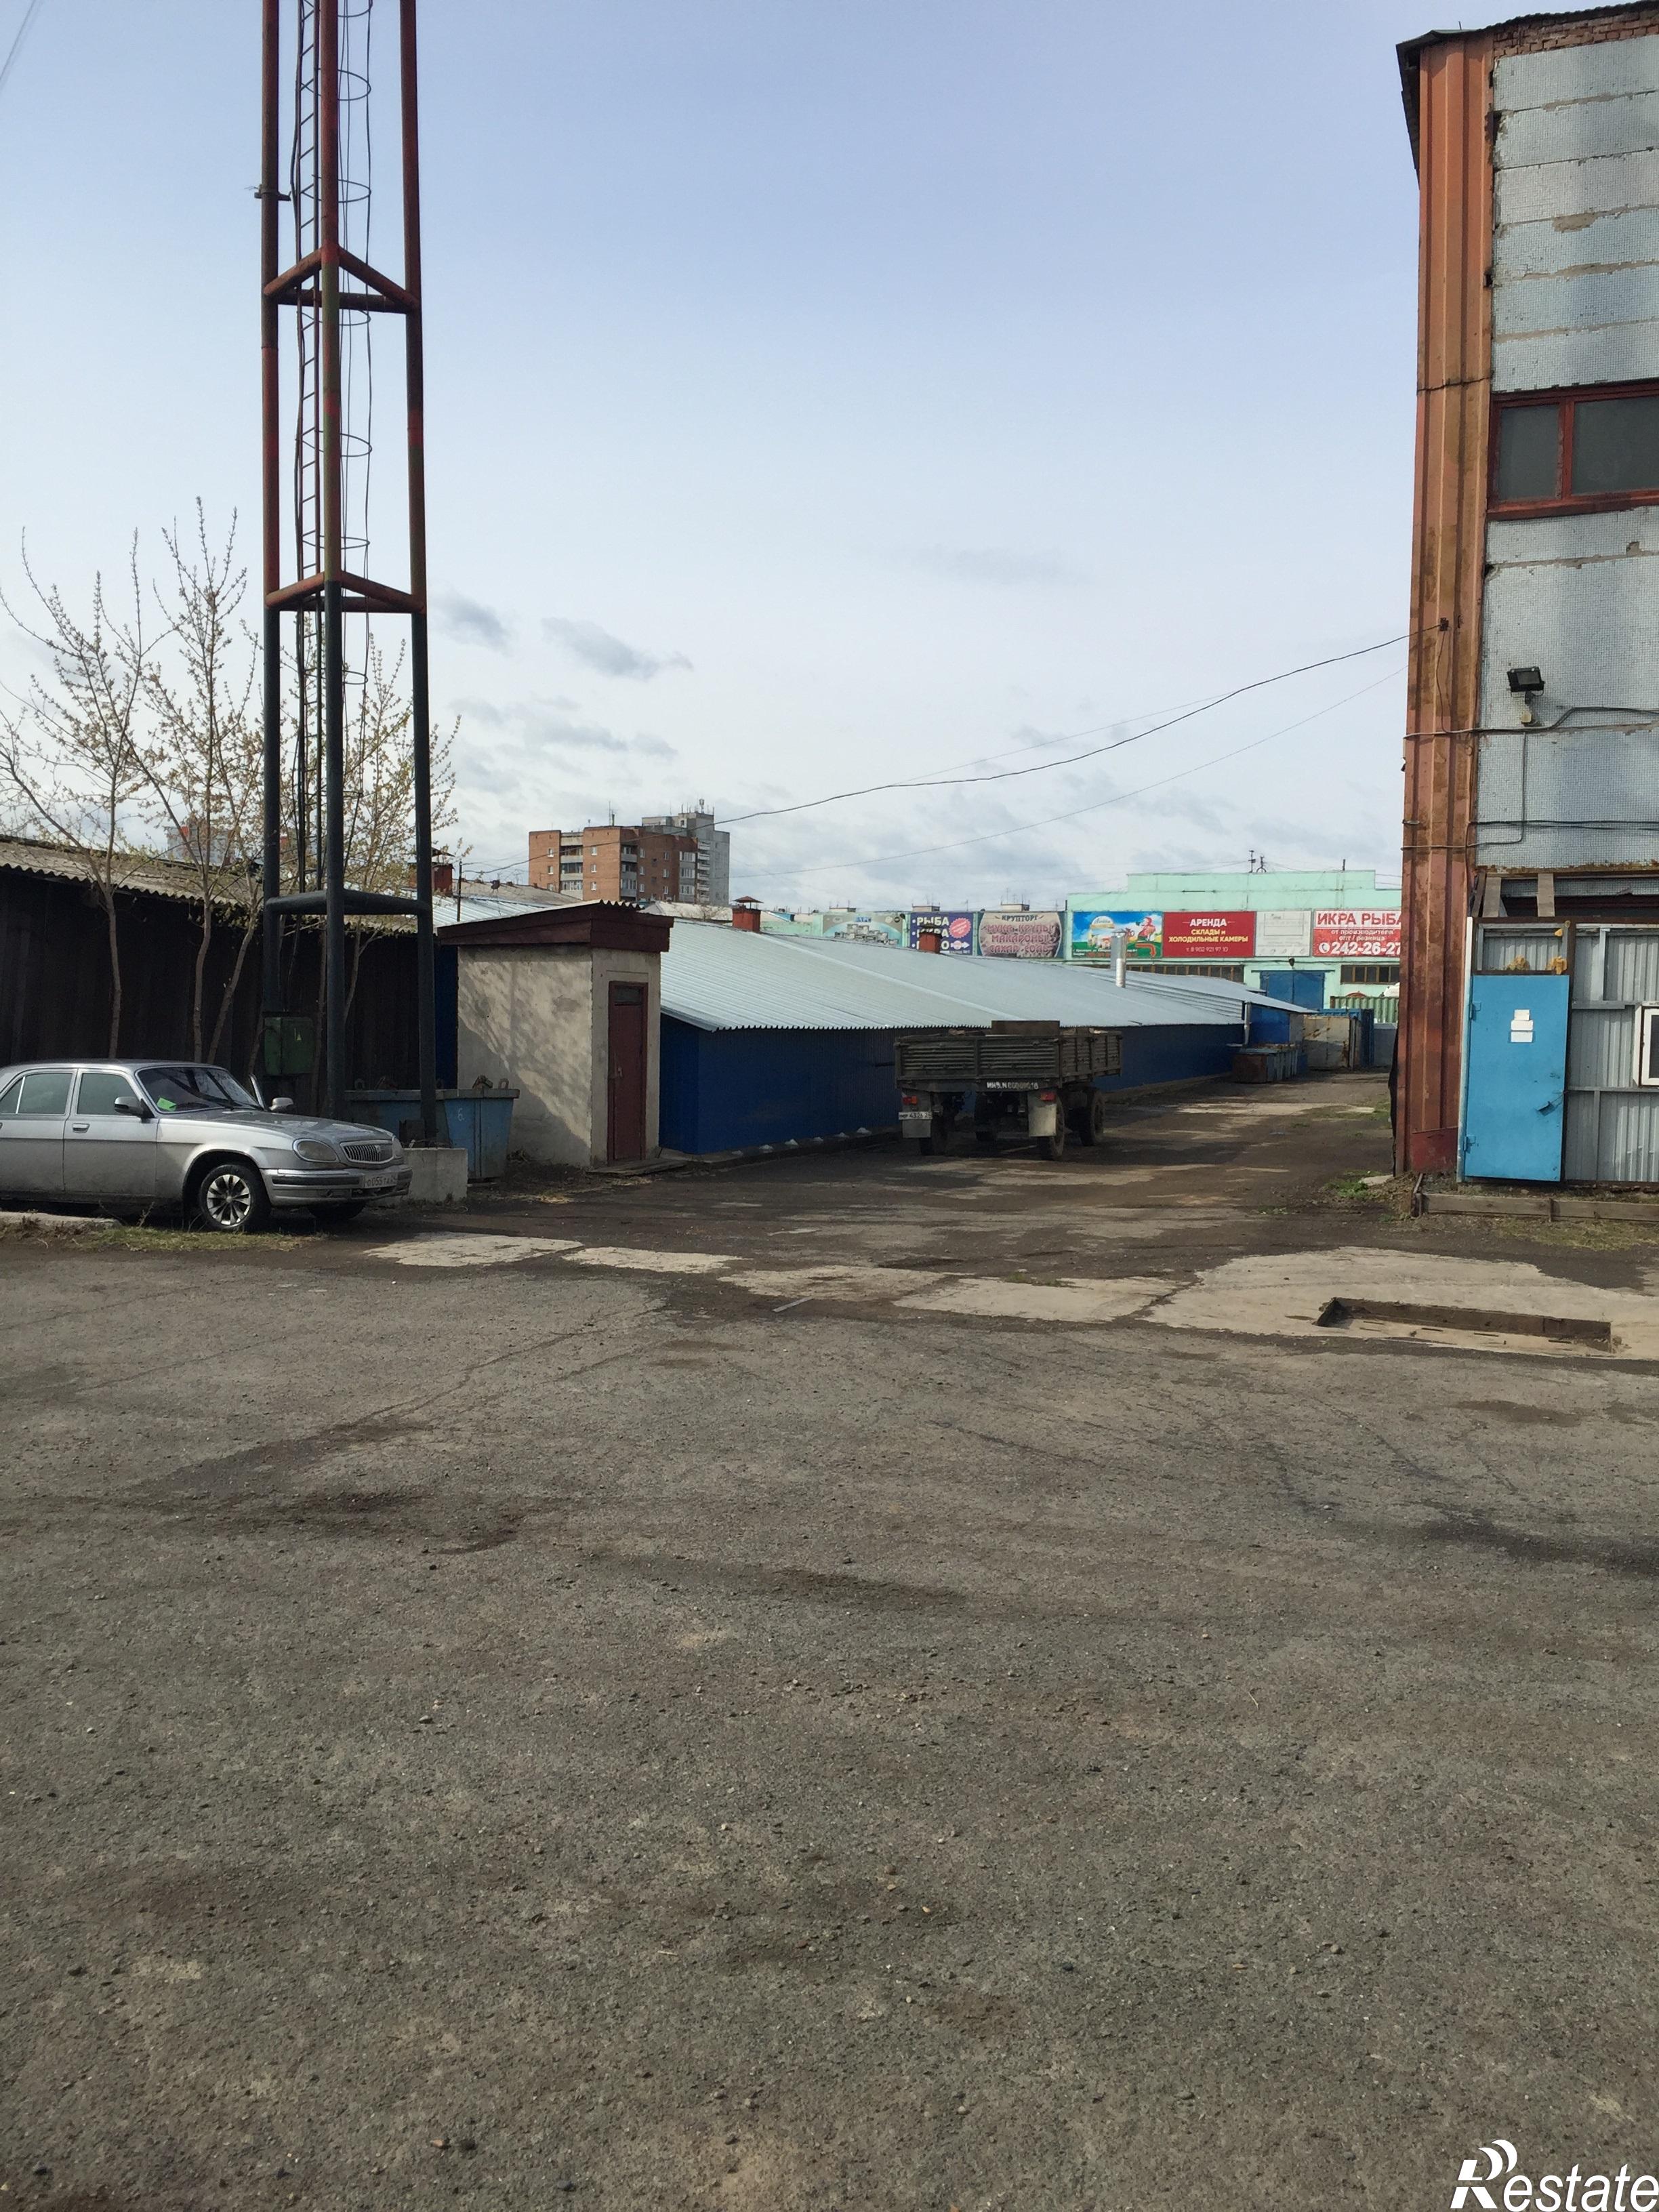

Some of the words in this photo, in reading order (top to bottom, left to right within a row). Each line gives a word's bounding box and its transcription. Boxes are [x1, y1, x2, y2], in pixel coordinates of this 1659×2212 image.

[916, 917, 949, 926] РЫБА
[1189, 918, 1227, 927] АРЕНДА
[1317, 913, 1356, 925] ИКРА
[991, 935, 1048, 943] МАКАРОНЫ
